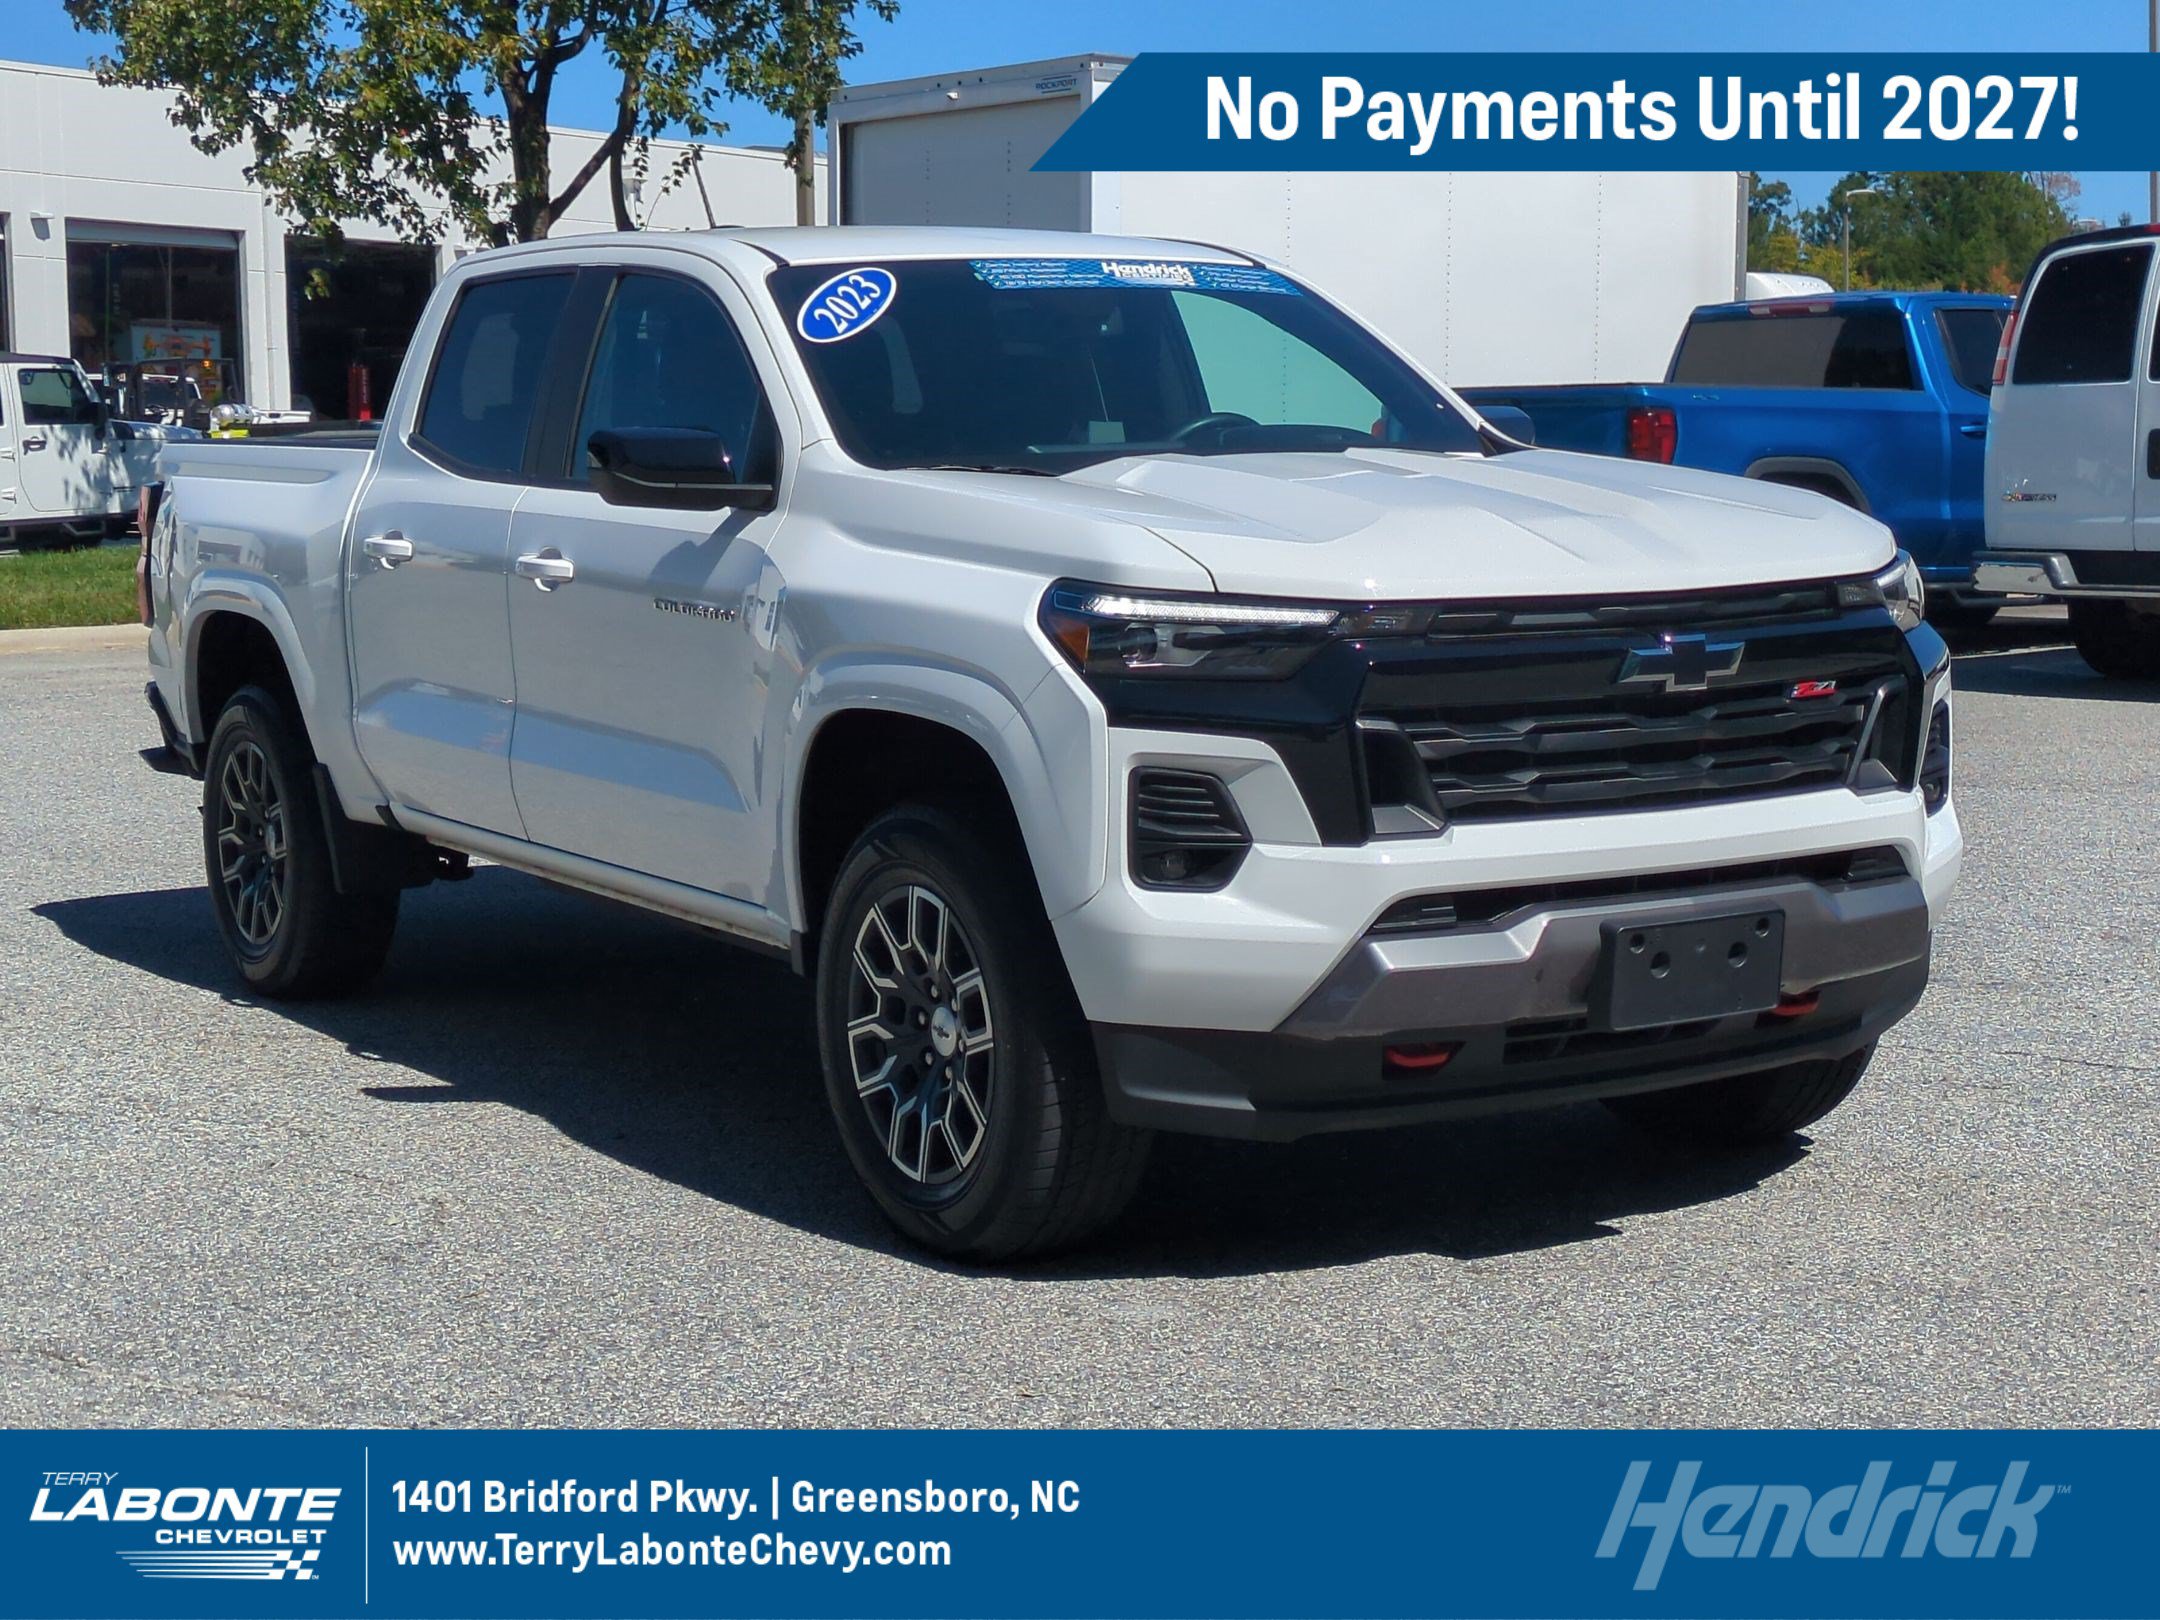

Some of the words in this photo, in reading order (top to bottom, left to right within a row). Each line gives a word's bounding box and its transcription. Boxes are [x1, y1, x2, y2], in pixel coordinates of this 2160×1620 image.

[1035, 79, 1077, 89] ROCKPORT
[1101, 262, 1192, 278] Hendrick
[813, 275, 880, 334] 2023
